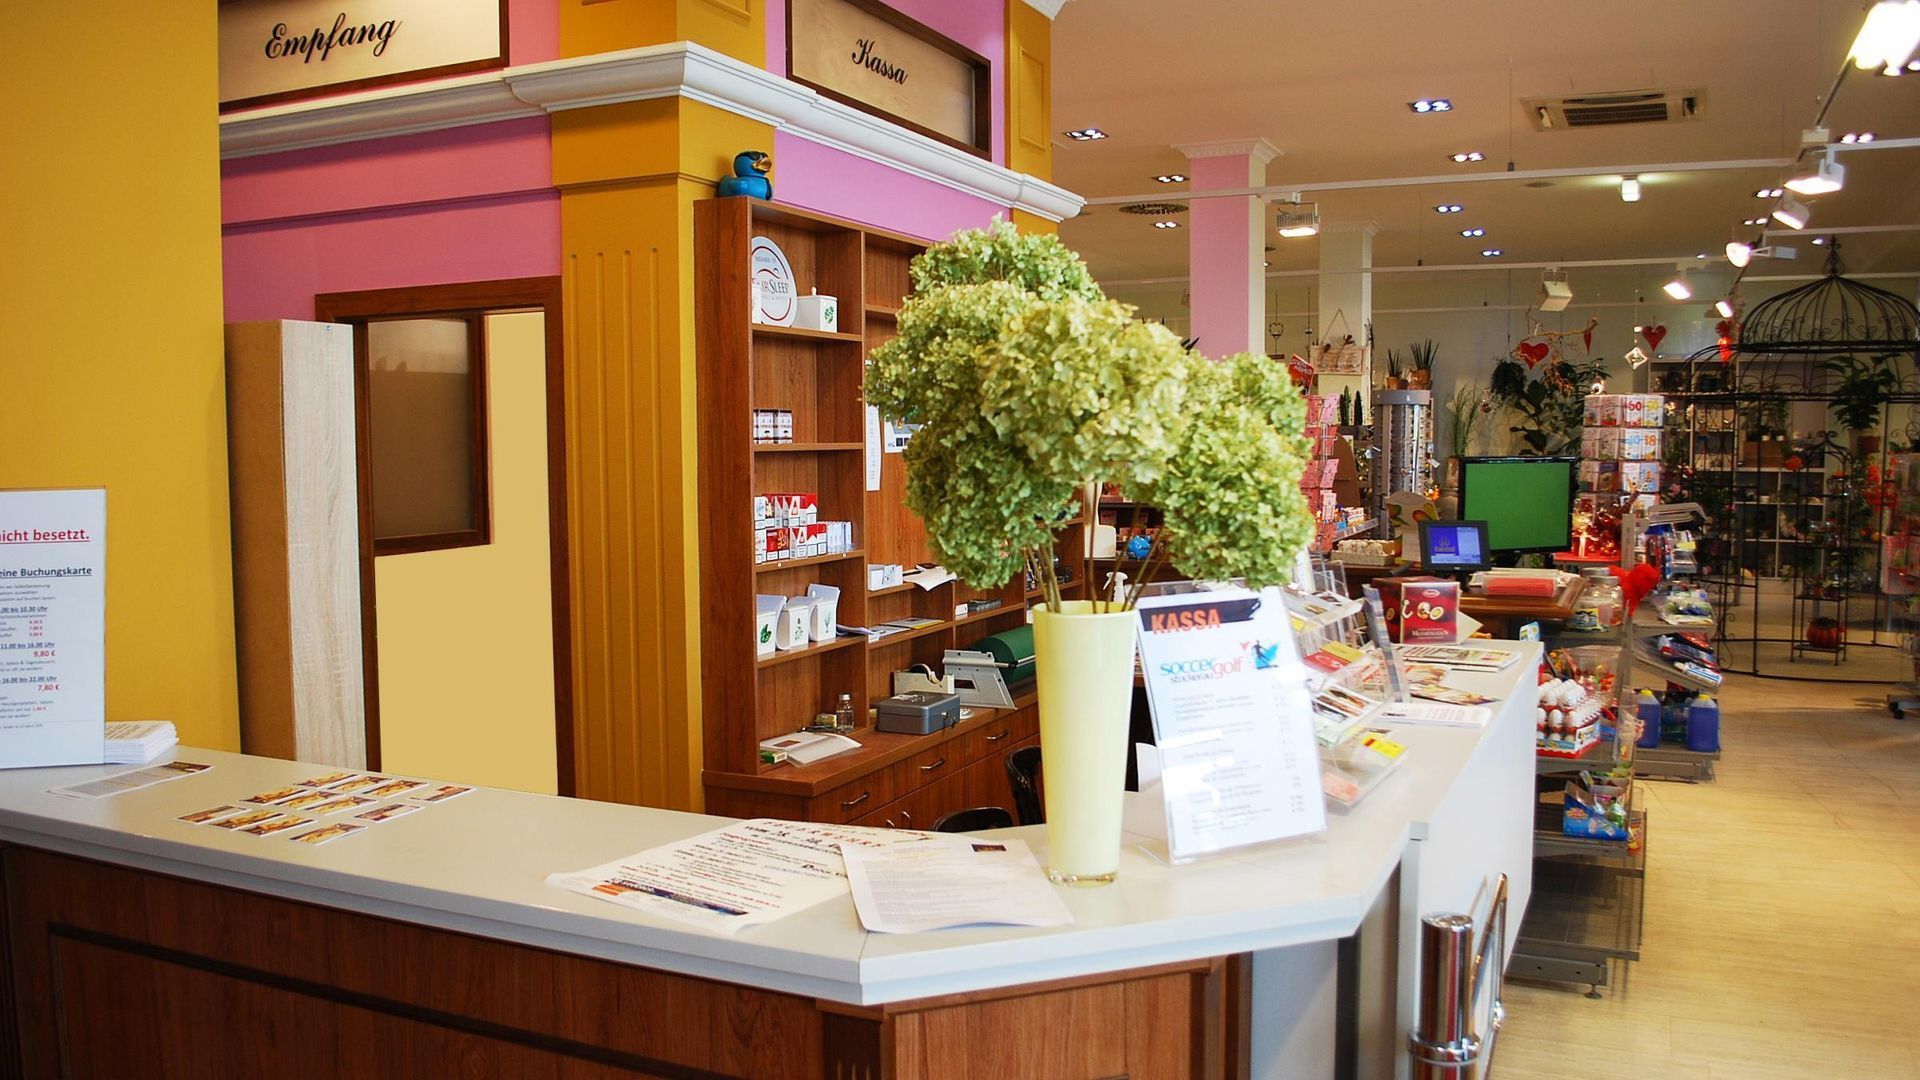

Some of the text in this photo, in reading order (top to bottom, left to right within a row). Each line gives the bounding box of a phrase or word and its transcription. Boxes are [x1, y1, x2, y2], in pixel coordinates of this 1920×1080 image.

[264, 12, 402, 64] Empfang
[851, 38, 909, 85] Kassa
[0, 528, 90, 542] icht besetzt.
[20, 566, 93, 578] Buchungskarte
[1150, 606, 1222, 634] KASSA
